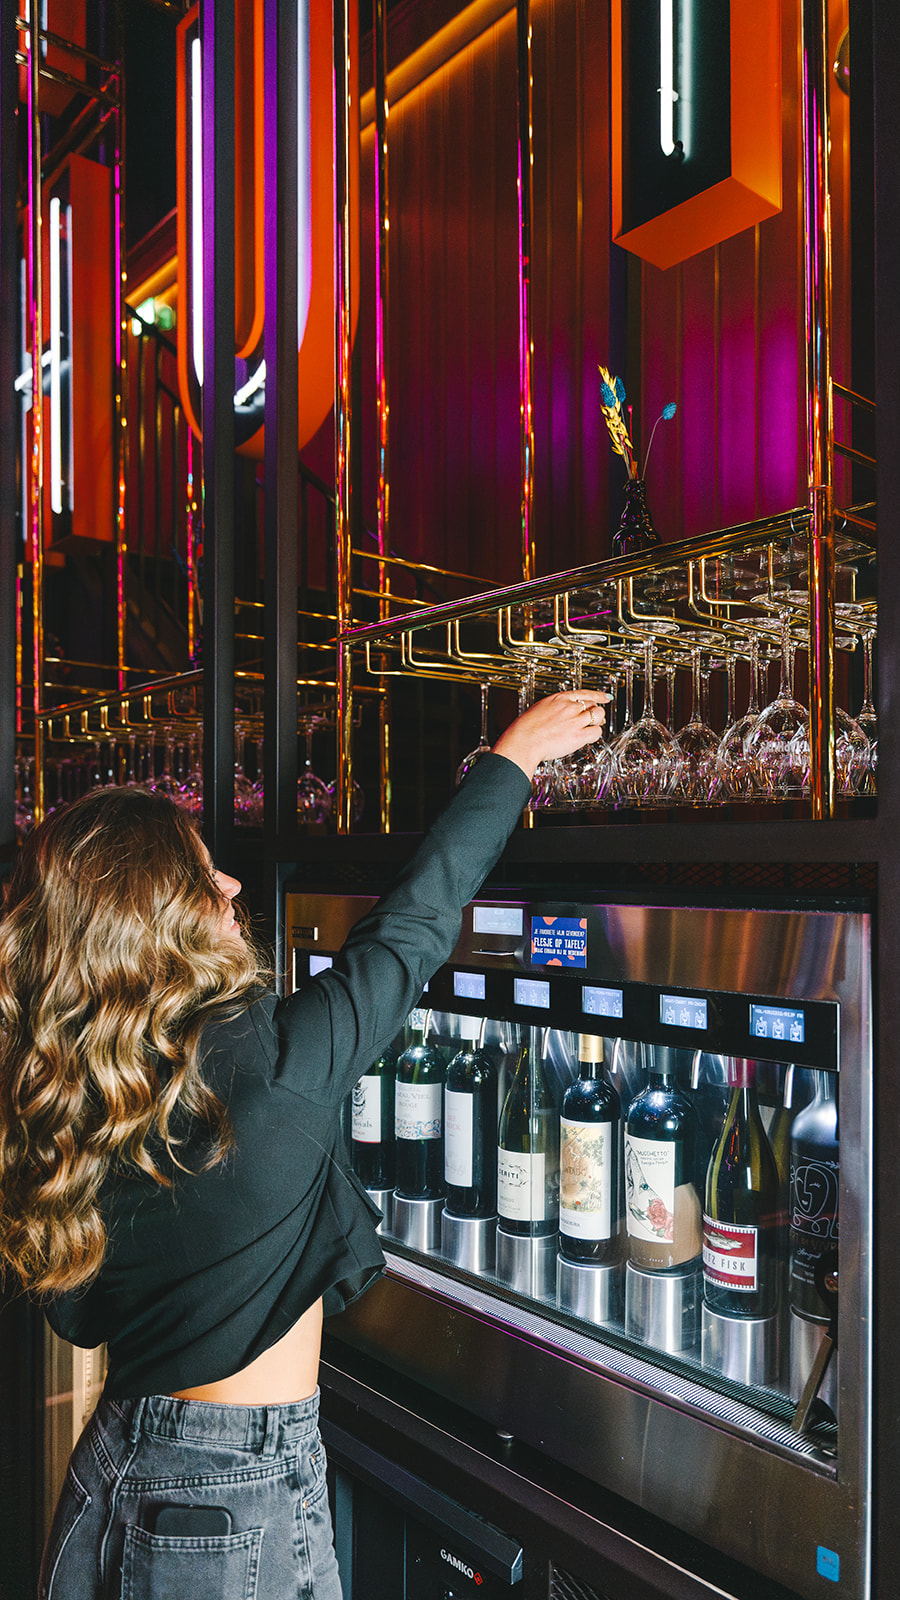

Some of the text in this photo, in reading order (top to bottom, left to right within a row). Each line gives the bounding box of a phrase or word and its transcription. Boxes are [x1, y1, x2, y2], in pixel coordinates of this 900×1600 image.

[534, 937, 584, 949] FLESJE OP TAFEL?
[721, 1258, 746, 1272] FISK
[441, 1549, 474, 1579] GAMKO
